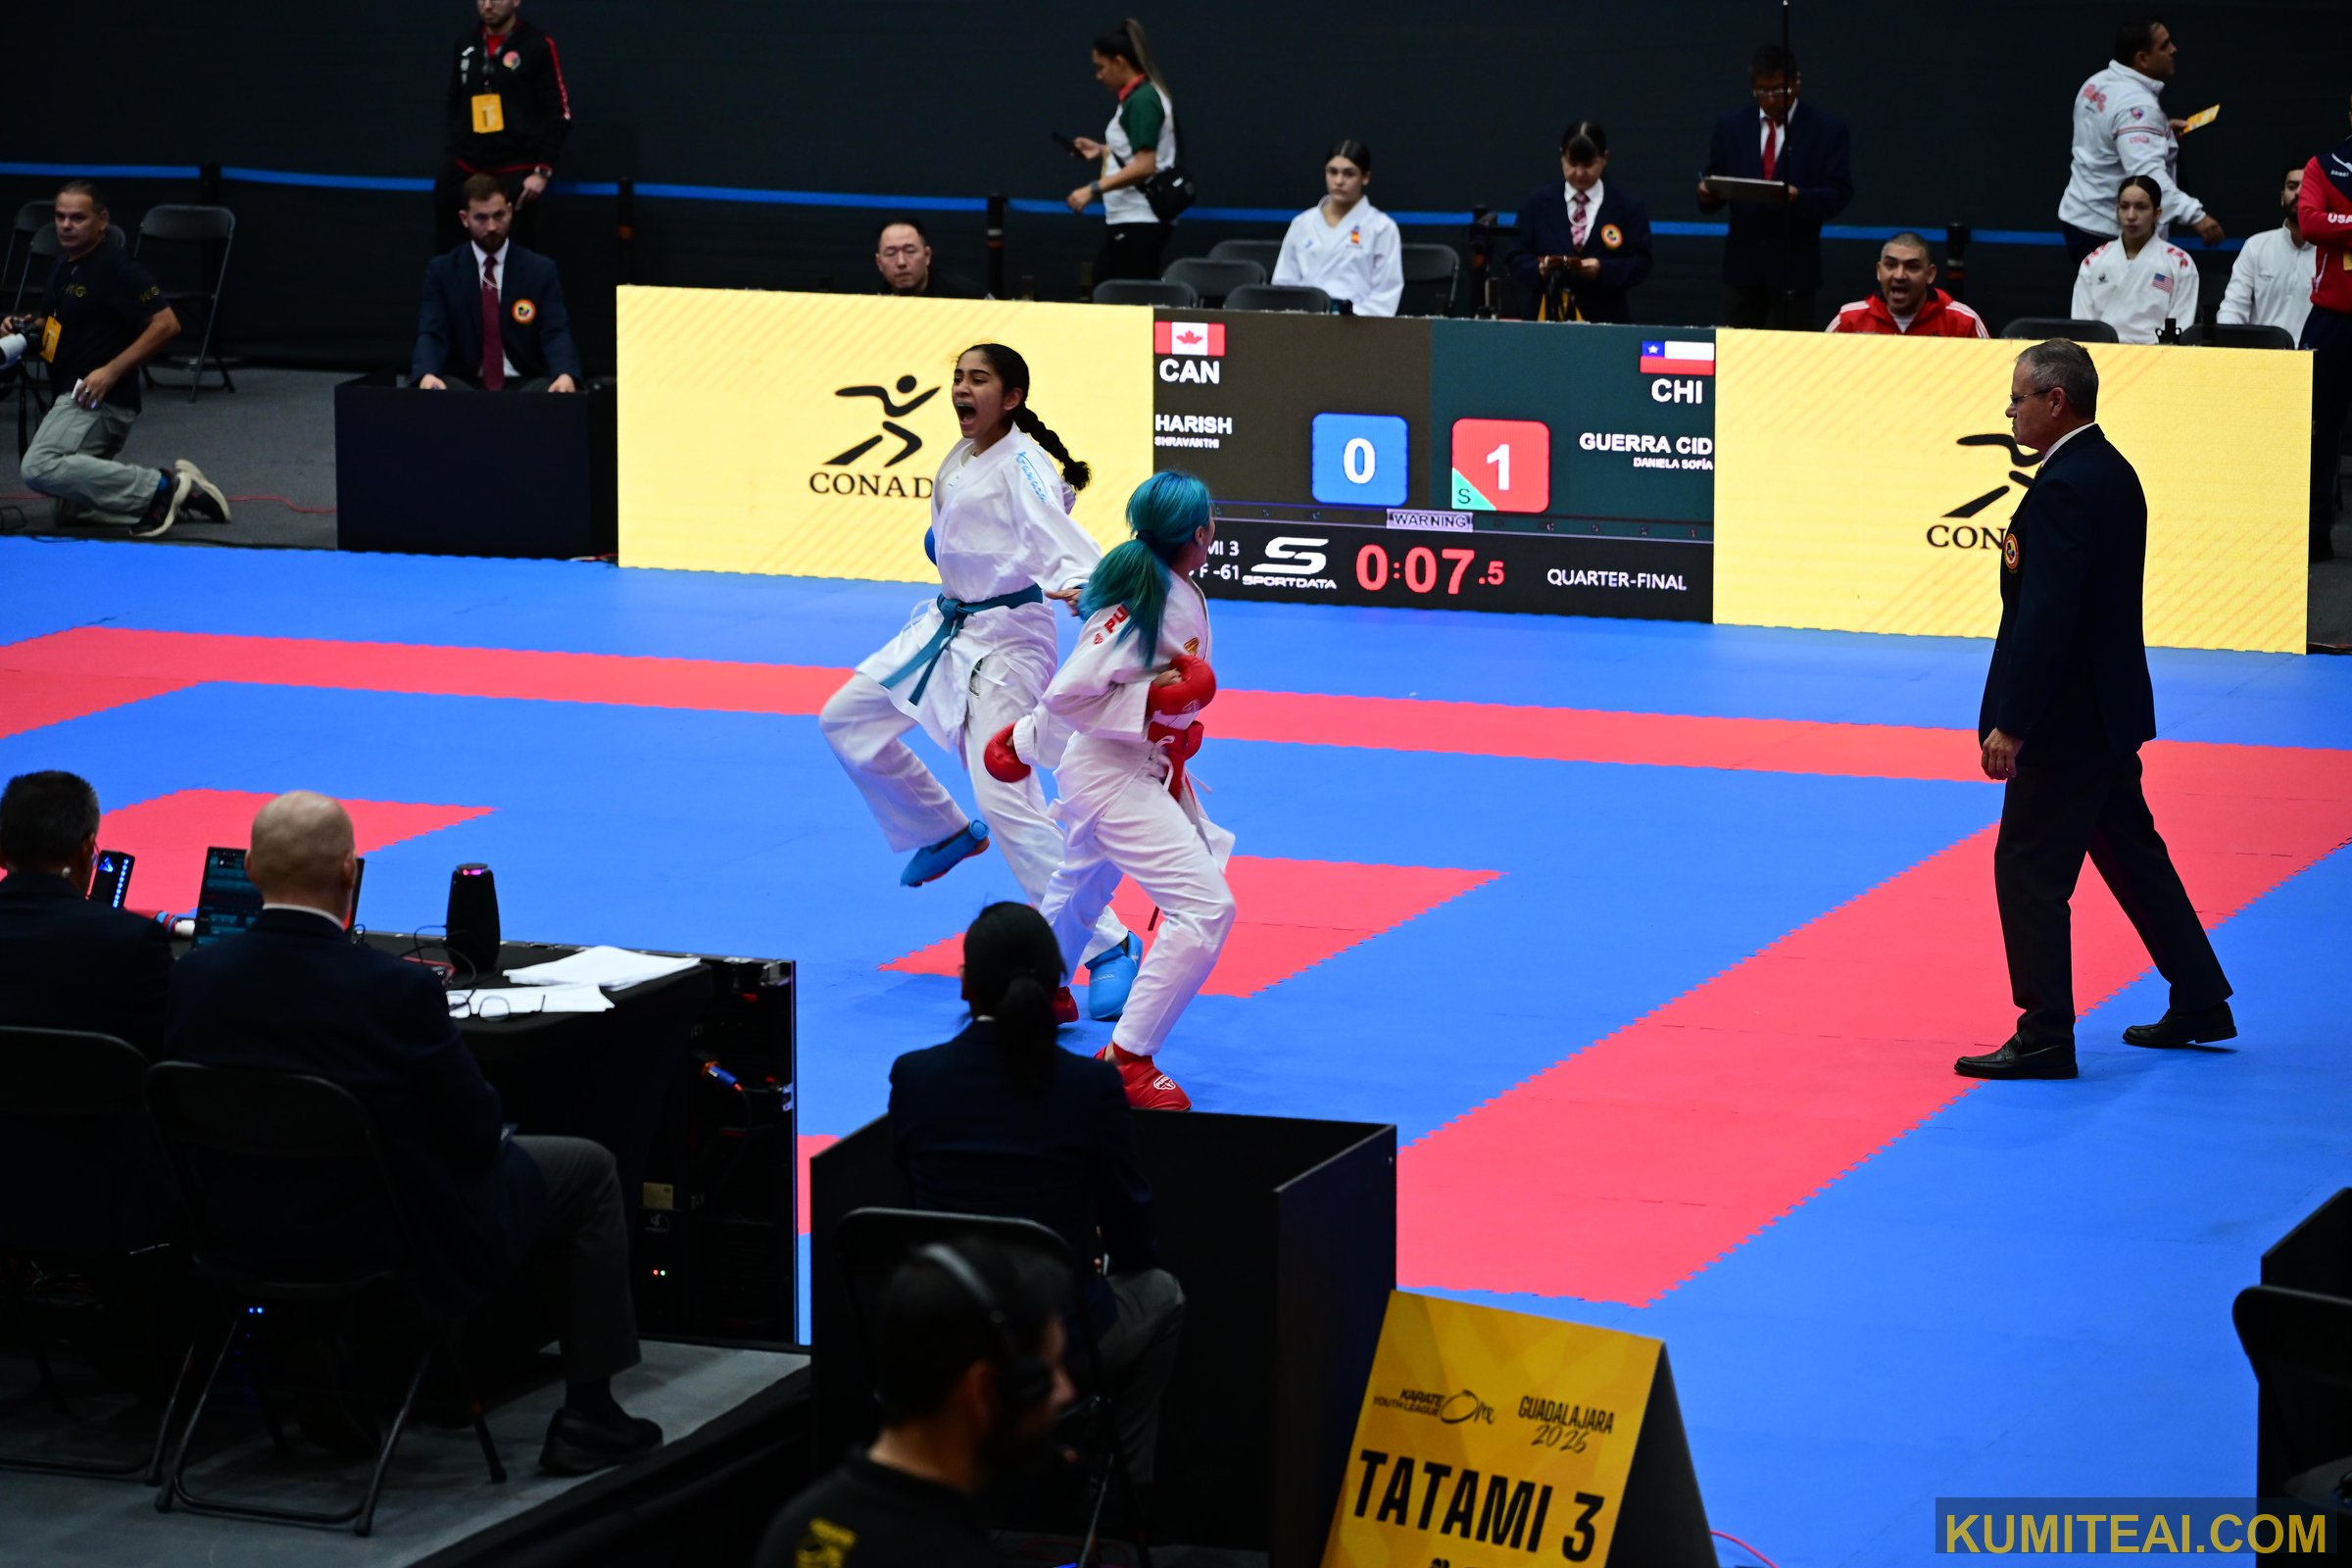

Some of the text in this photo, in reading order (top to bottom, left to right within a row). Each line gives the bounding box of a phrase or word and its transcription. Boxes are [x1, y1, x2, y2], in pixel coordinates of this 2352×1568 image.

[1158, 359, 1220, 384] CAN
[1651, 377, 1703, 404] CHI
[1154, 414, 1233, 434] HARISH
[1579, 432, 1713, 455] GUERRA CID
[1343, 437, 1376, 484] 0
[1486, 443, 1510, 491] 1
[1633, 457, 1713, 470] DANIELA SOFÍA
[808, 470, 934, 500] CONAD
[1457, 488, 1472, 505] S
[1394, 514, 1467, 528] WARNING
[1228, 540, 1240, 557] 3
[1926, 524, 2006, 550] CON
[1212, 564, 1240, 580] -61
[1242, 574, 1338, 590] SPORTDATA
[1546, 567, 1688, 591] QUARTER-FINAL
[1372, 1396, 1403, 1409] YOUTH
[1399, 1388, 1446, 1408] KARATE
[1518, 1395, 1616, 1434] GUADALAJARA
[1530, 1424, 1591, 1454] 2026
[1353, 1448, 1605, 1563] TATAMI 3
